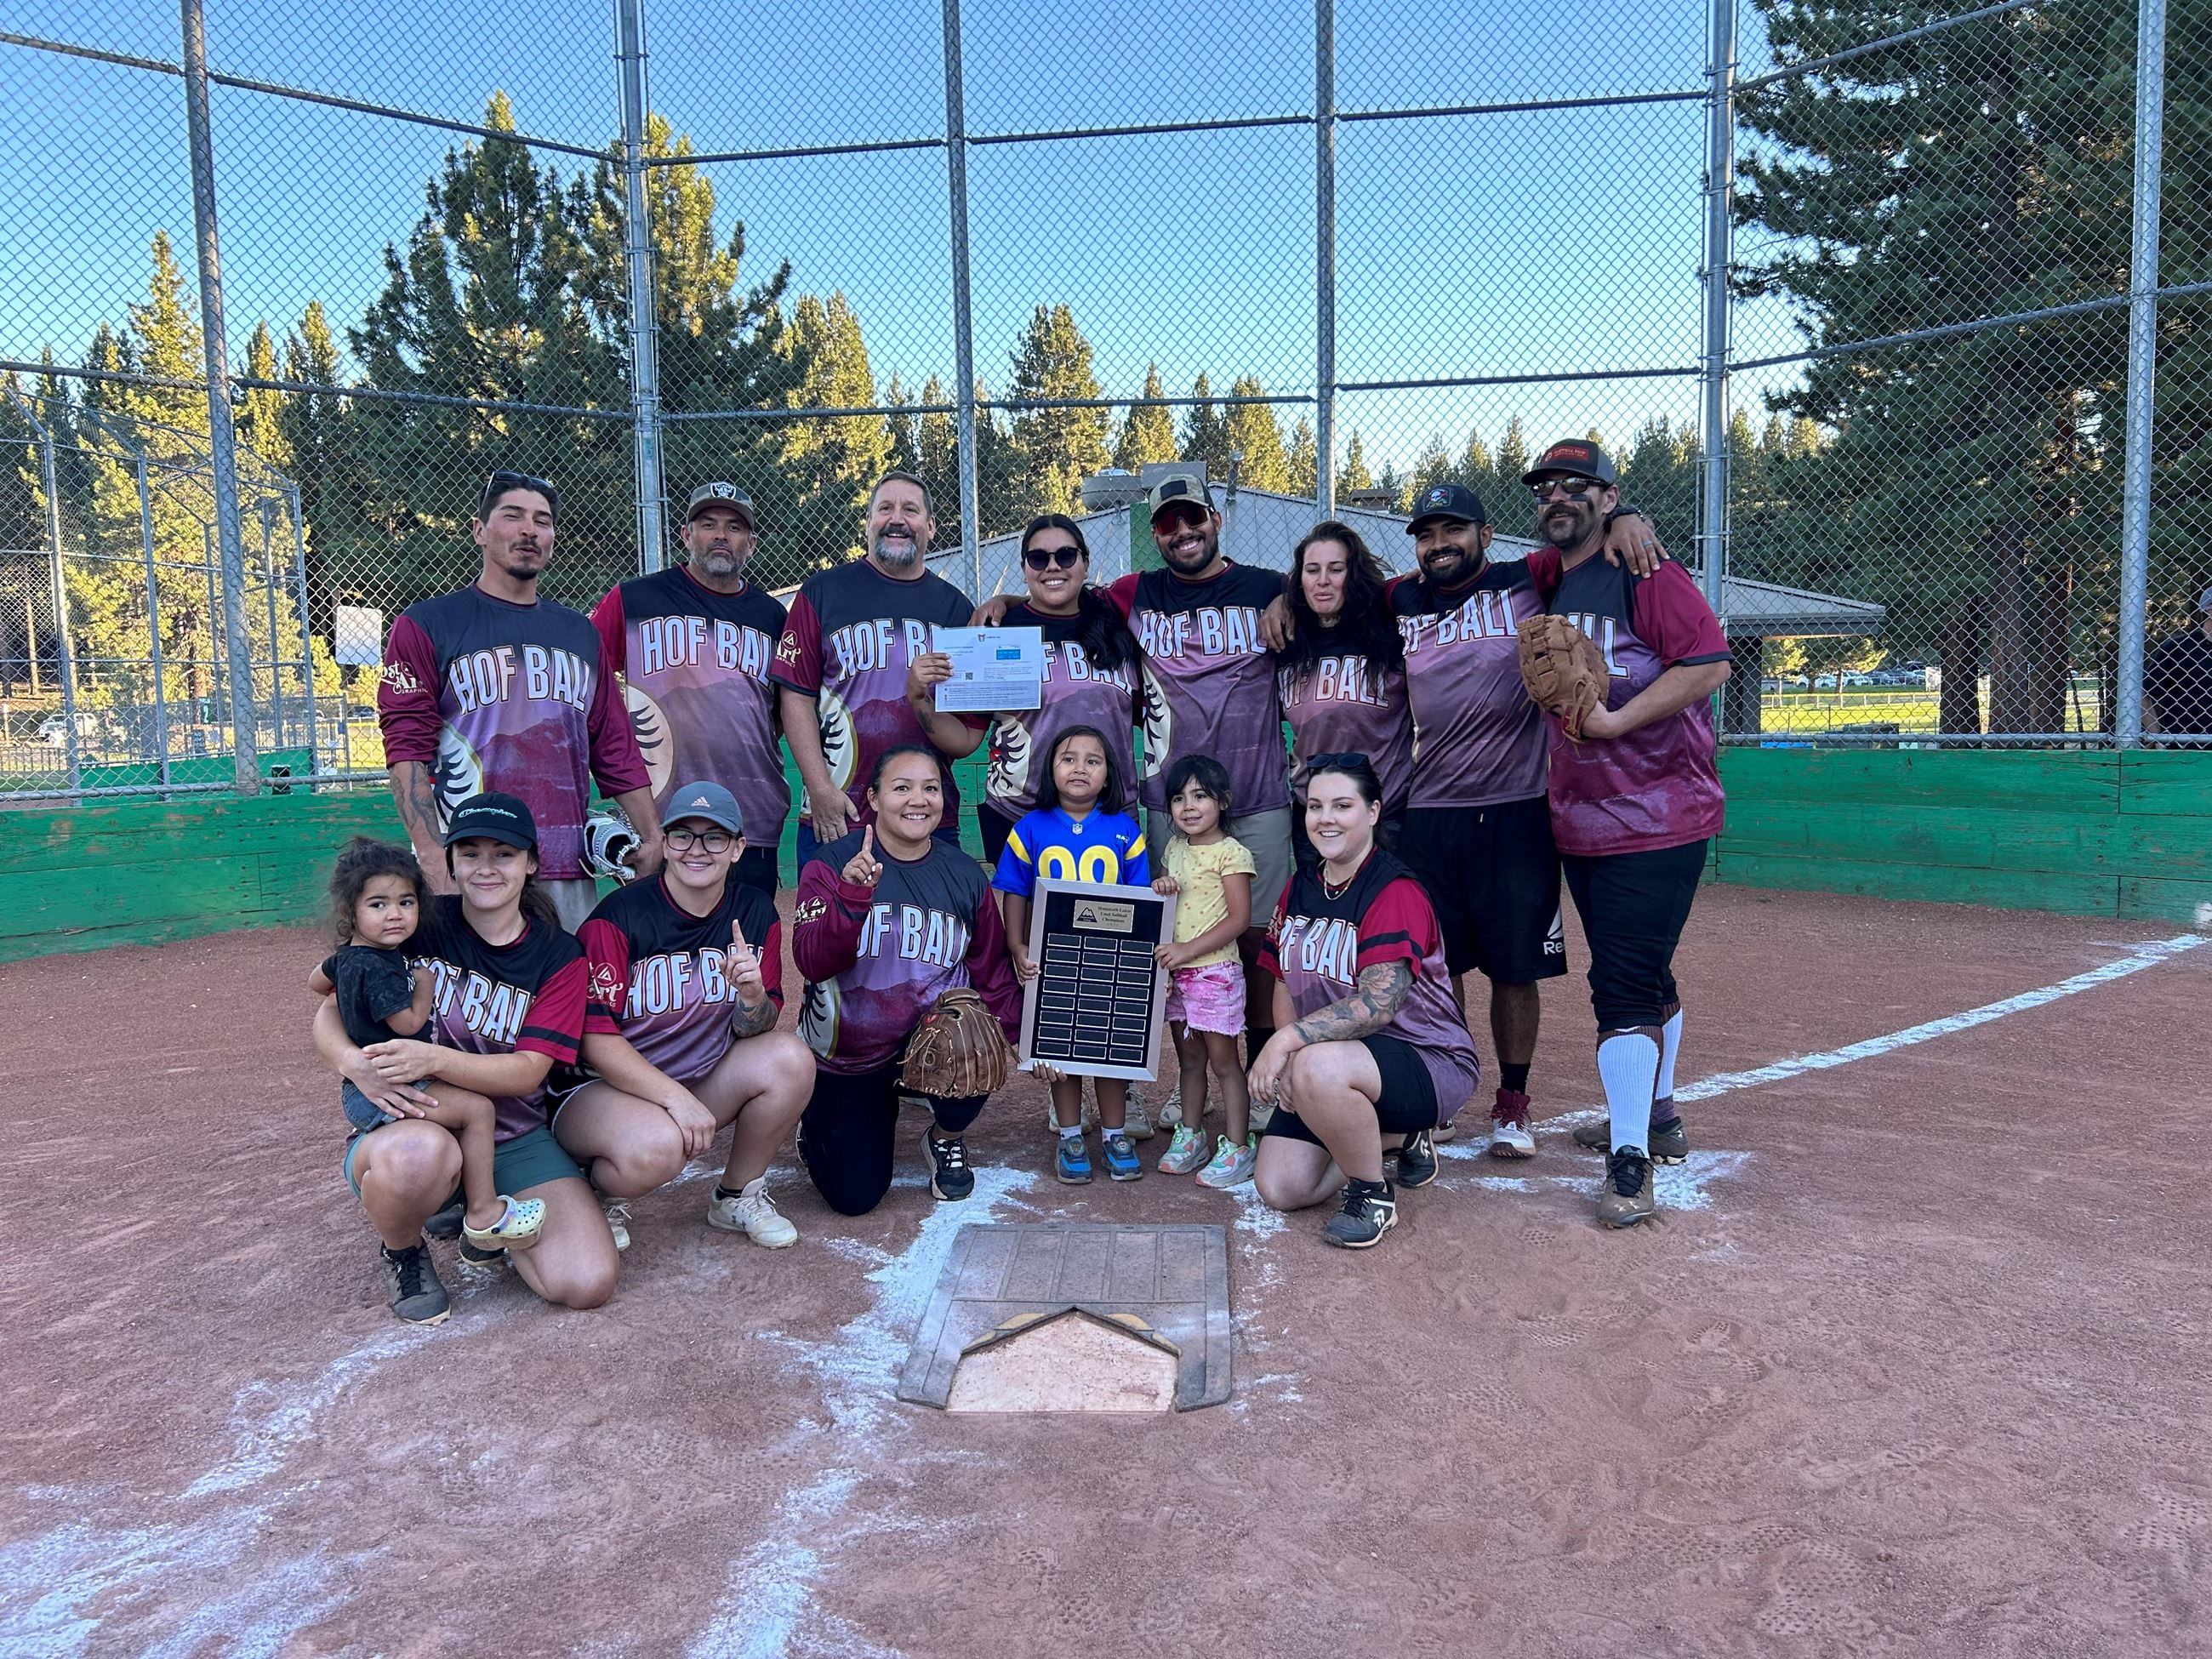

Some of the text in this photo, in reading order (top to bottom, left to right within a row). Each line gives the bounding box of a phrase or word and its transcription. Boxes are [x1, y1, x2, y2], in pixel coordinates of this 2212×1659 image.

[1138, 607, 1268, 659] HOF BAL
[1434, 588, 1518, 647] BALL
[380, 660, 400, 679] ost
[448, 645, 516, 715] HOF
[639, 615, 773, 687] HOF BAL
[830, 619, 895, 684] HOF
[1314, 655, 1388, 710] BALL
[459, 807, 517, 818] Champion
[1279, 915, 1311, 973] OF
[410, 956, 462, 1018] OF
[461, 970, 531, 1046] BAL
[622, 951, 693, 1021] HOF
